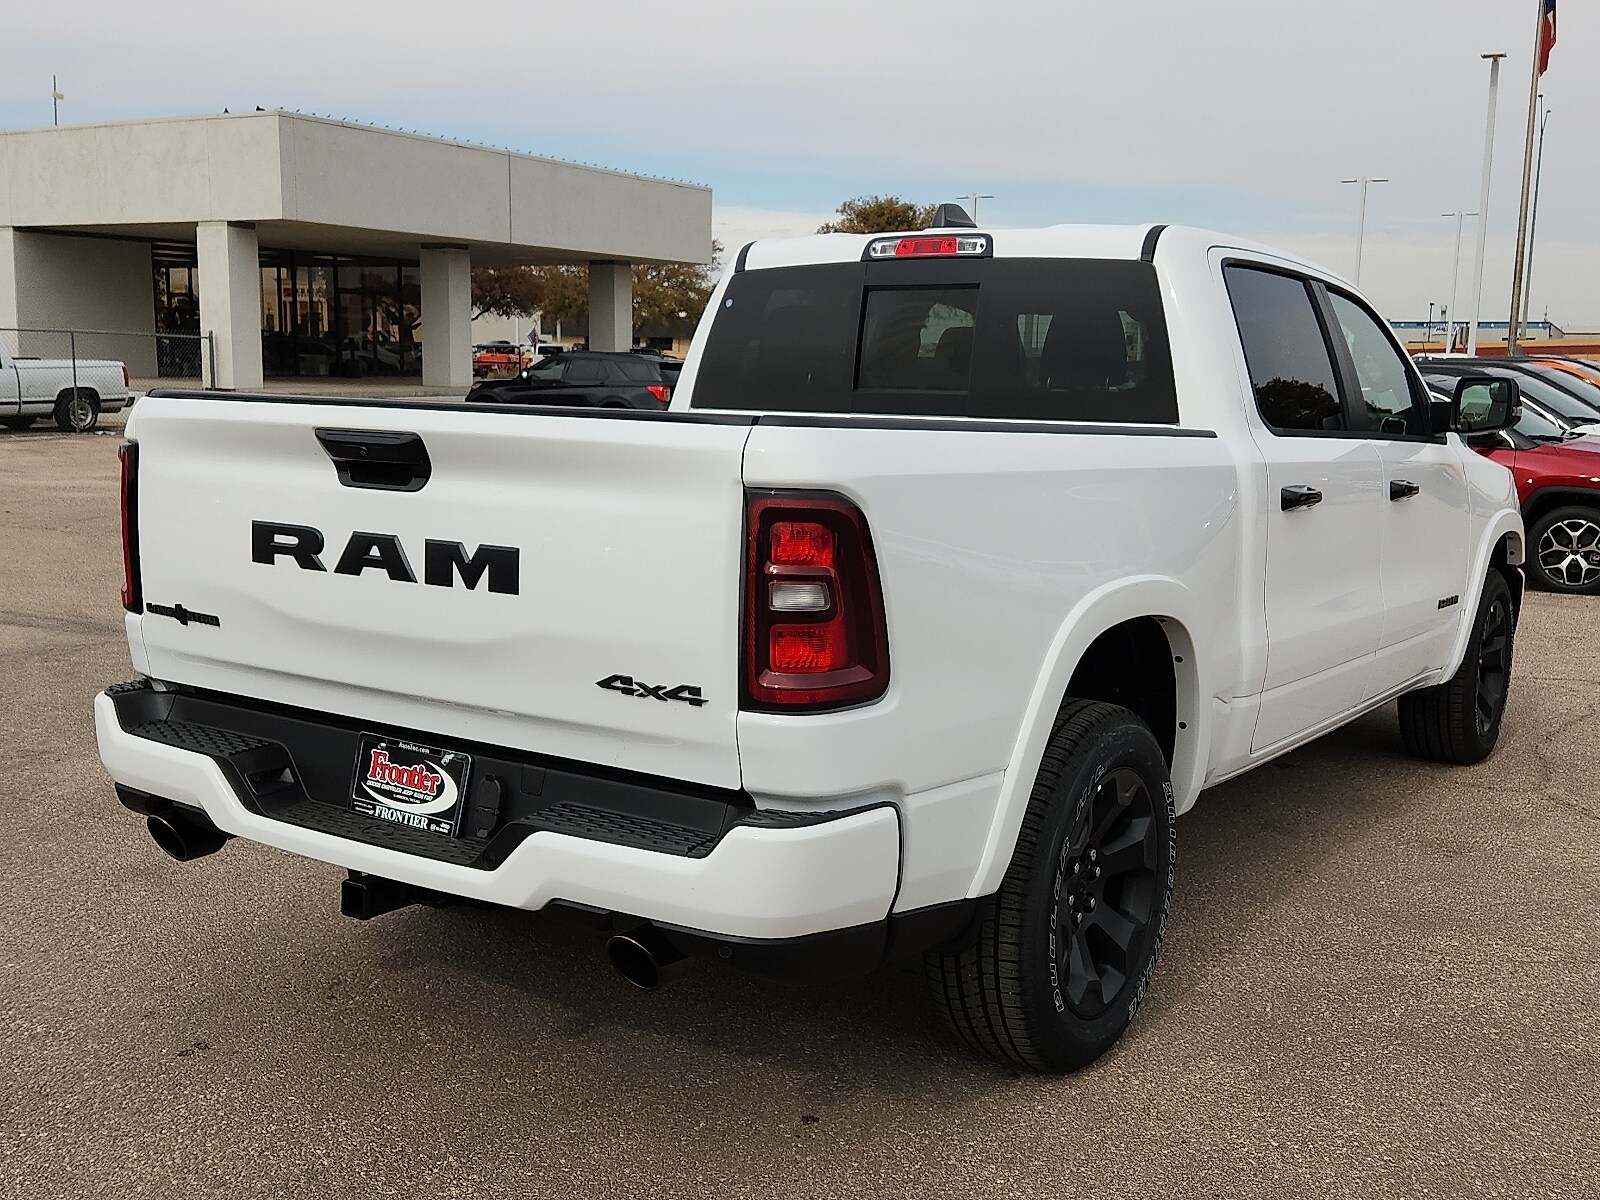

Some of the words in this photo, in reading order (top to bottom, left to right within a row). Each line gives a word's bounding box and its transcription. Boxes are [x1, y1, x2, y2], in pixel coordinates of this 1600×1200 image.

[252, 520, 520, 595] RAM
[368, 749, 442, 795] Frontier
[374, 805, 428, 830] FRONTIER
